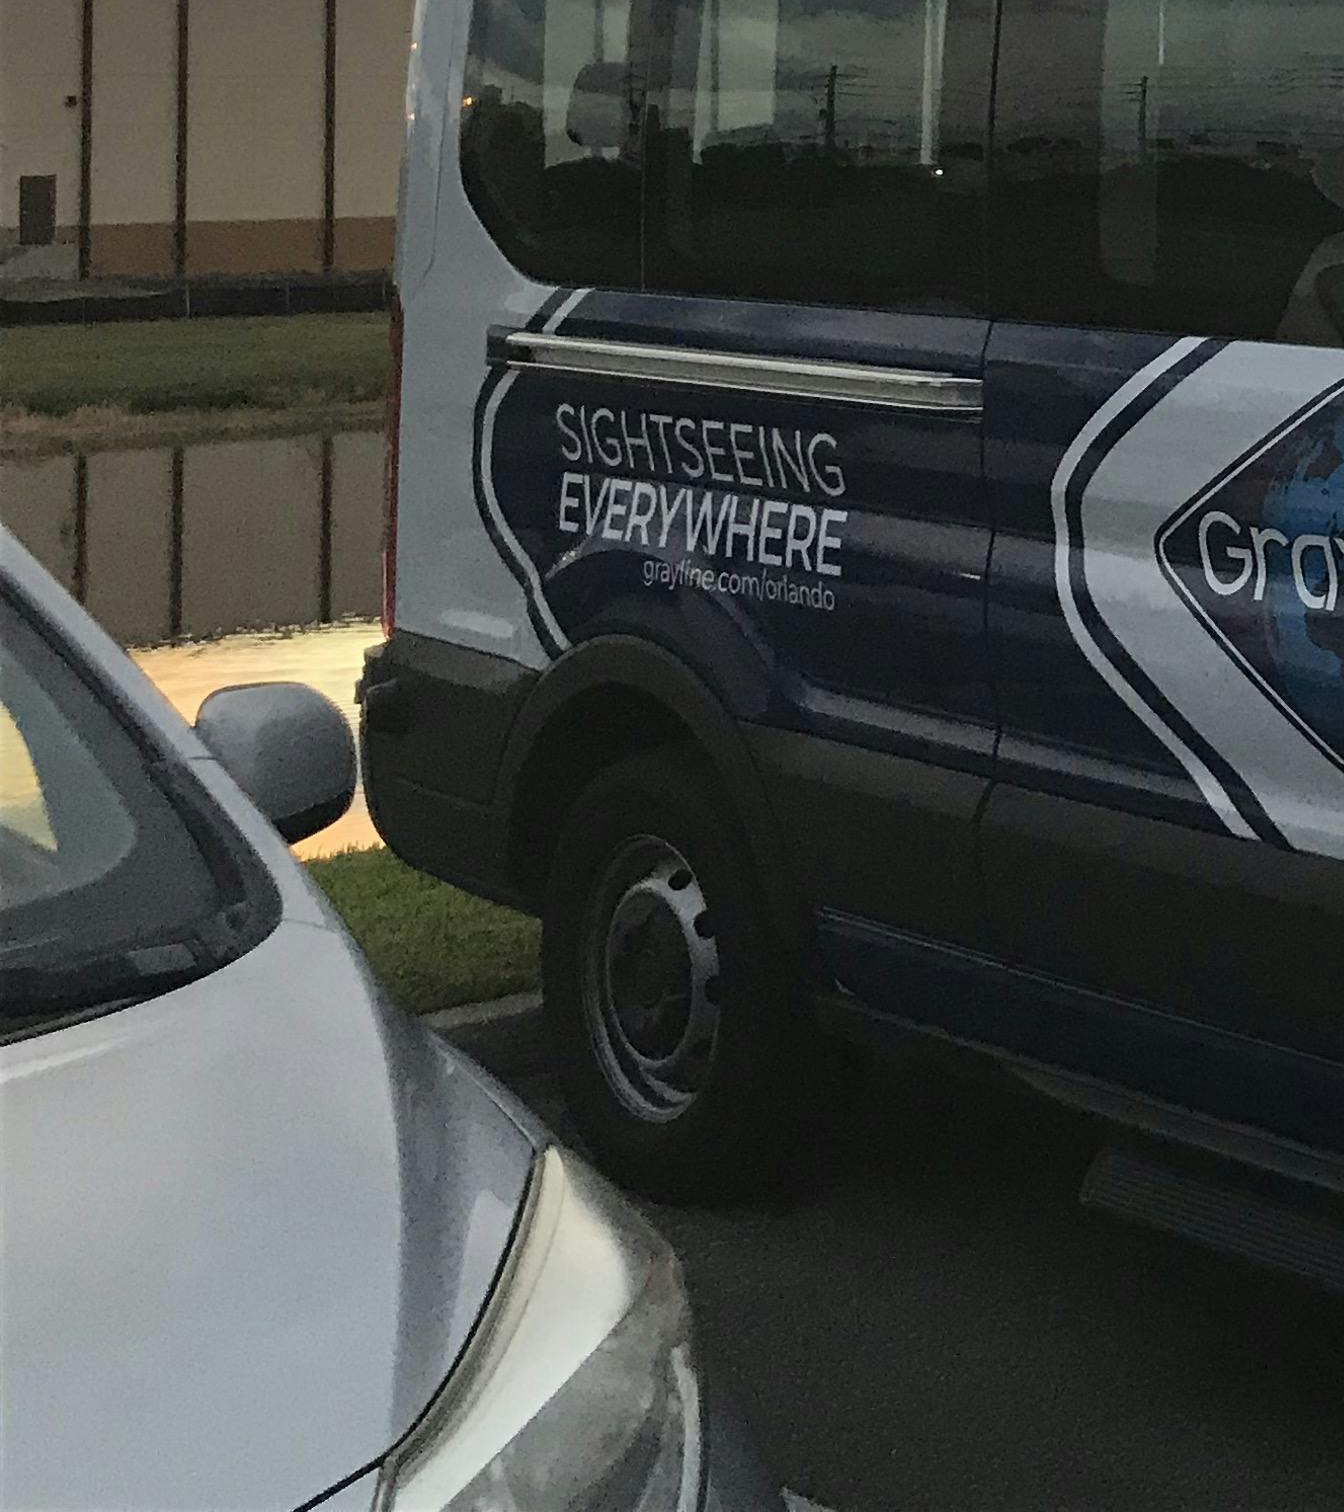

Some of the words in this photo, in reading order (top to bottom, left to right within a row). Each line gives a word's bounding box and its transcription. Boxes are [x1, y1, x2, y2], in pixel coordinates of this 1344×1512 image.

[556, 402, 846, 496] SIGHTSEEING
[559, 471, 848, 576] EVERYWHERE
[643, 557, 835, 611] grayline.com/orlando
